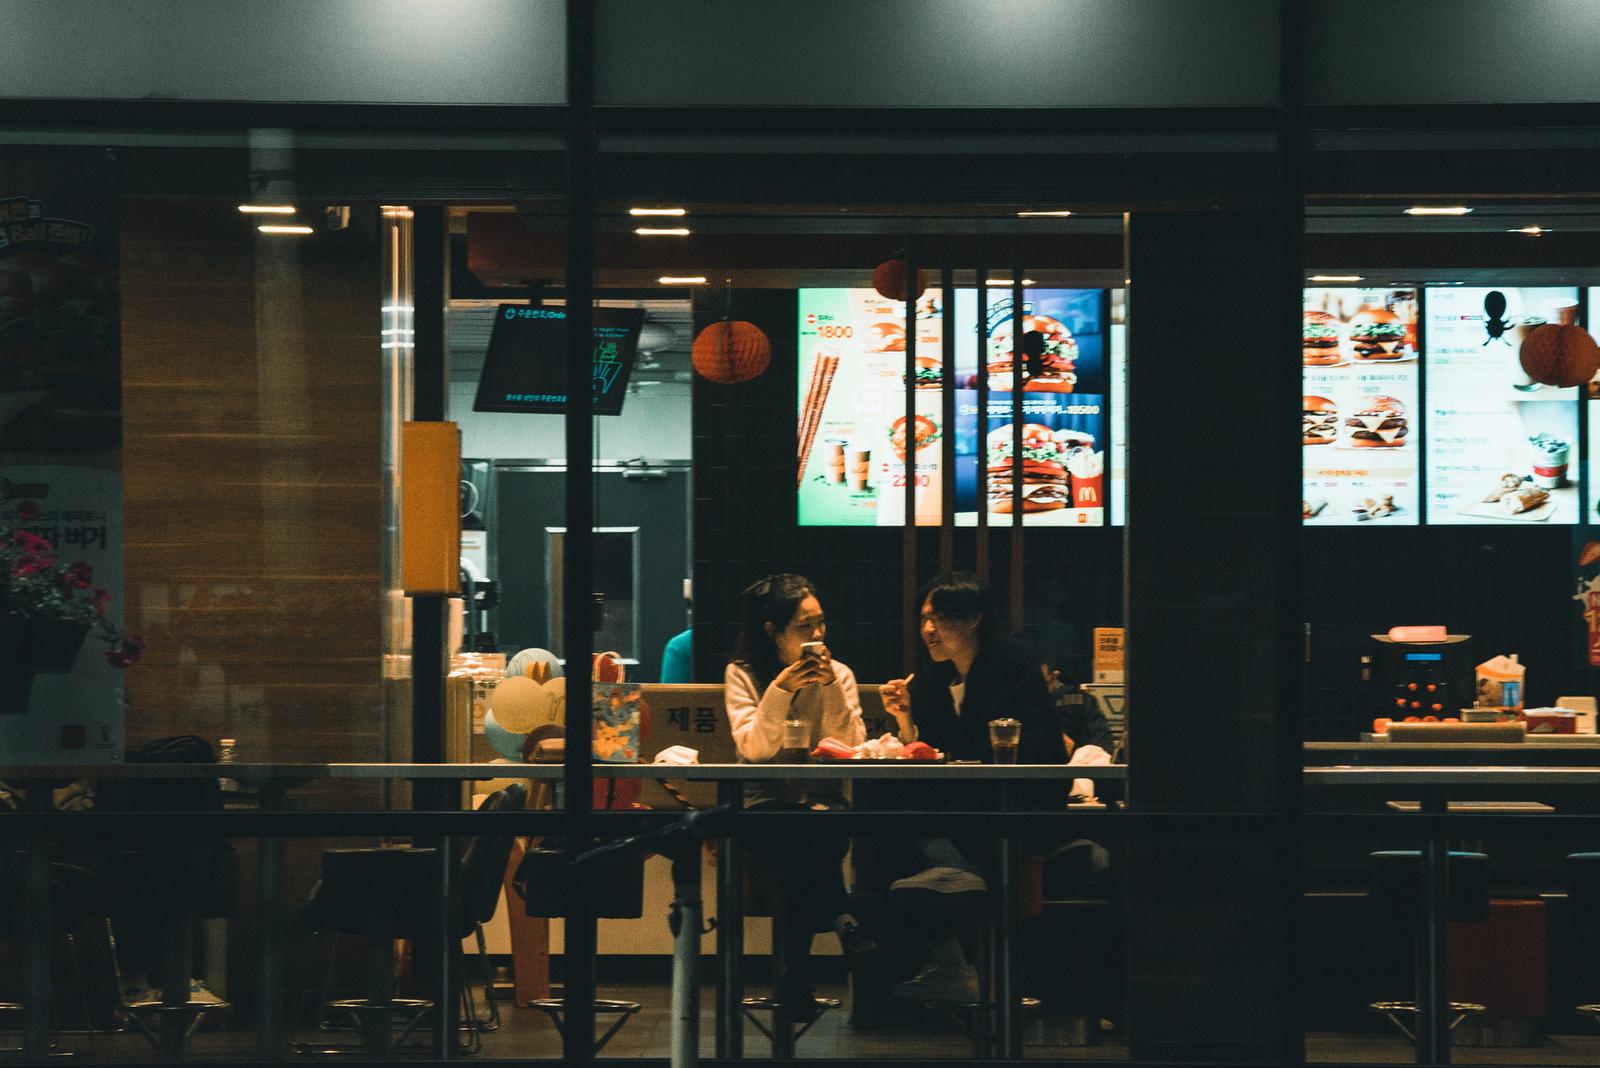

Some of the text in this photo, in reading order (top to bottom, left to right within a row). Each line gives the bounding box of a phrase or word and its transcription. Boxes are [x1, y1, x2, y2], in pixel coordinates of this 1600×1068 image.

[817, 325, 853, 338] 1800
[65, 526, 107, 549] 버거
[667, 705, 718, 733] 제품
